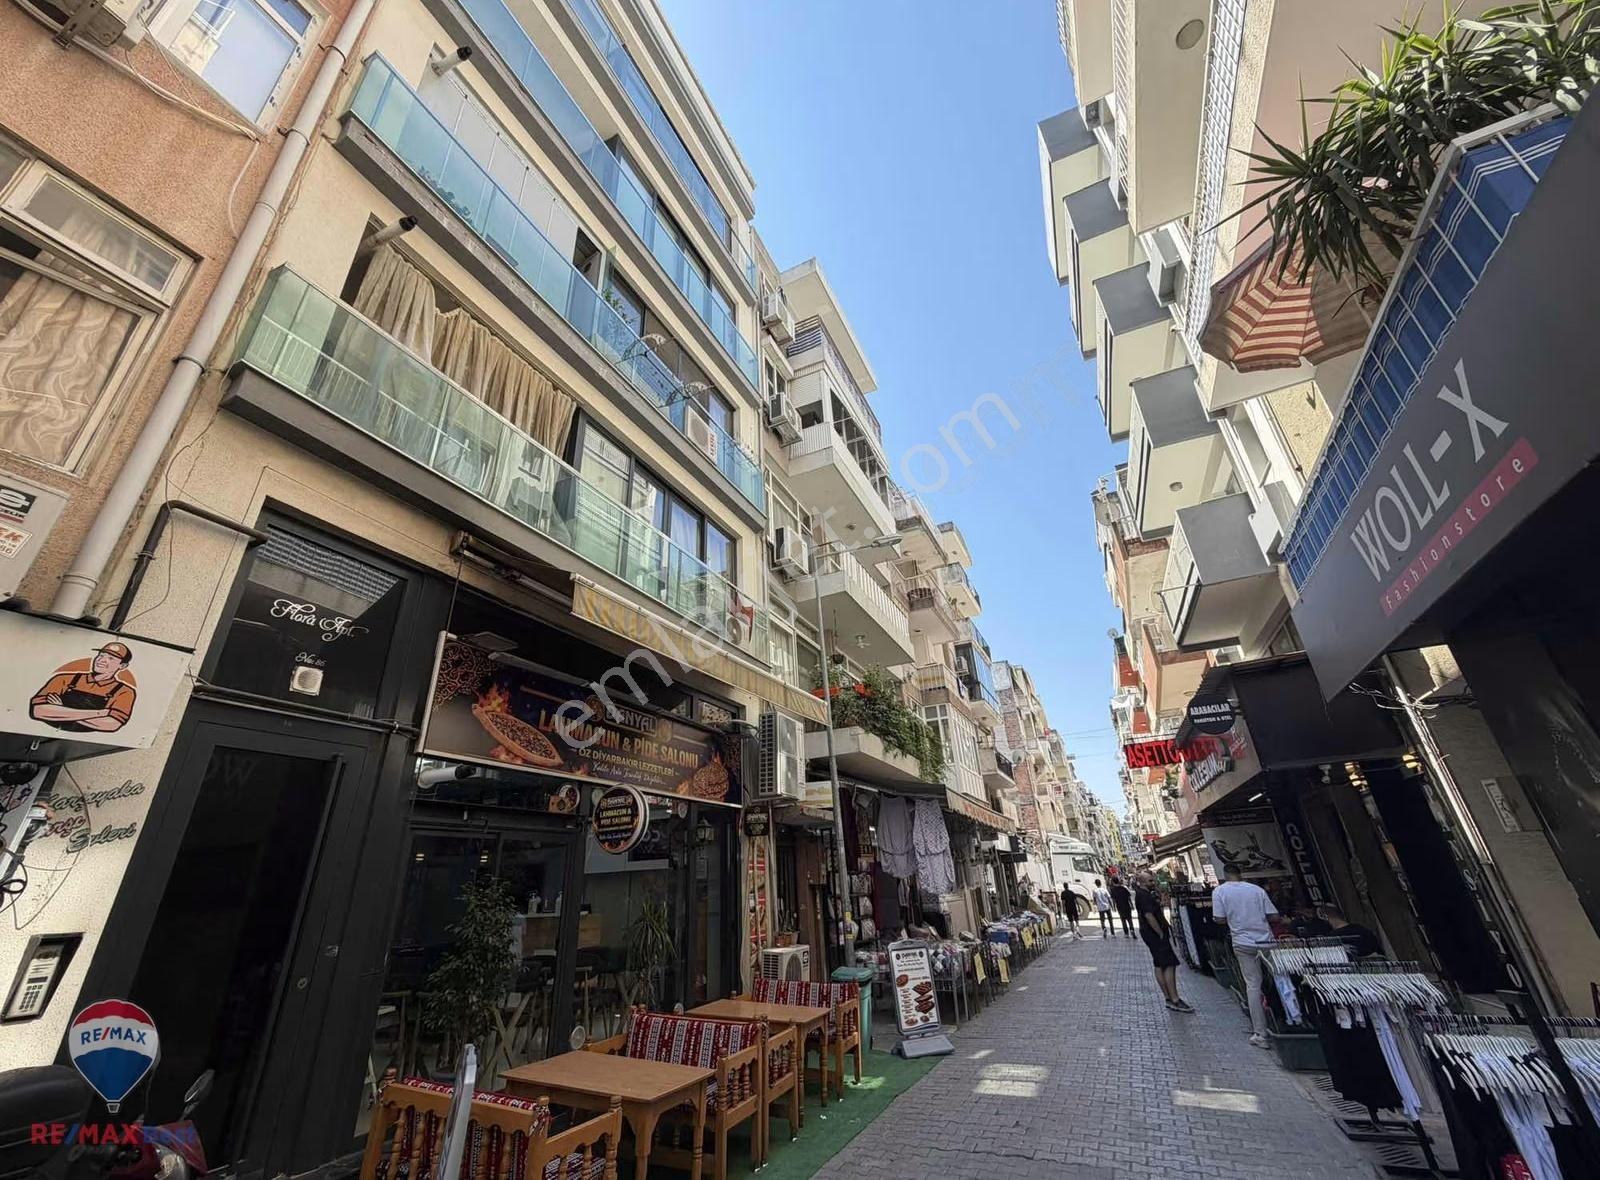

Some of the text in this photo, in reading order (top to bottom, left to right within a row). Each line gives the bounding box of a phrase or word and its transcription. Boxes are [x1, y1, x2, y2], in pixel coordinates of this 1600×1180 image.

[1350, 357, 1509, 583] WOLL-X
[270, 599, 316, 626] Flora
[622, 737, 631, 752] &
[661, 745, 698, 768] SALONU
